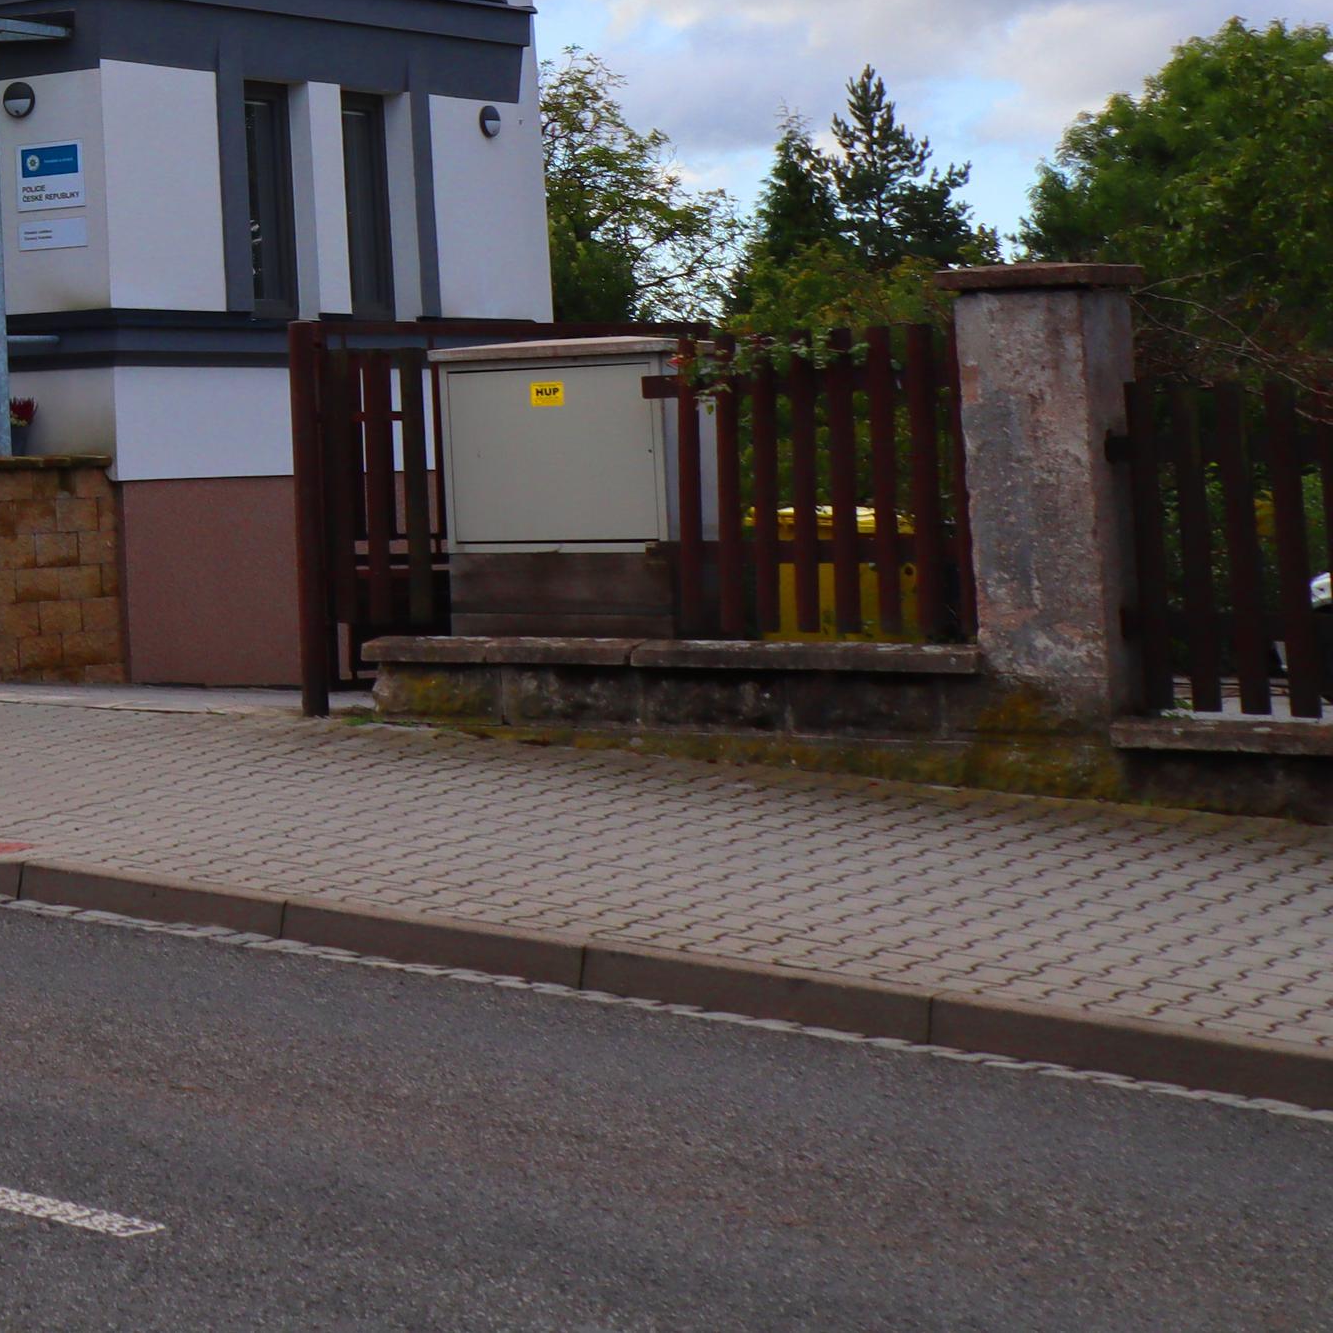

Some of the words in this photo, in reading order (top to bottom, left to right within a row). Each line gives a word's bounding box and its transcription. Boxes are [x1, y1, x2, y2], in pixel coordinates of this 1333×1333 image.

[22, 185, 45, 193] POLICIE
[44, 191, 80, 201] REPUBLIKY
[535, 387, 559, 397] HUP
